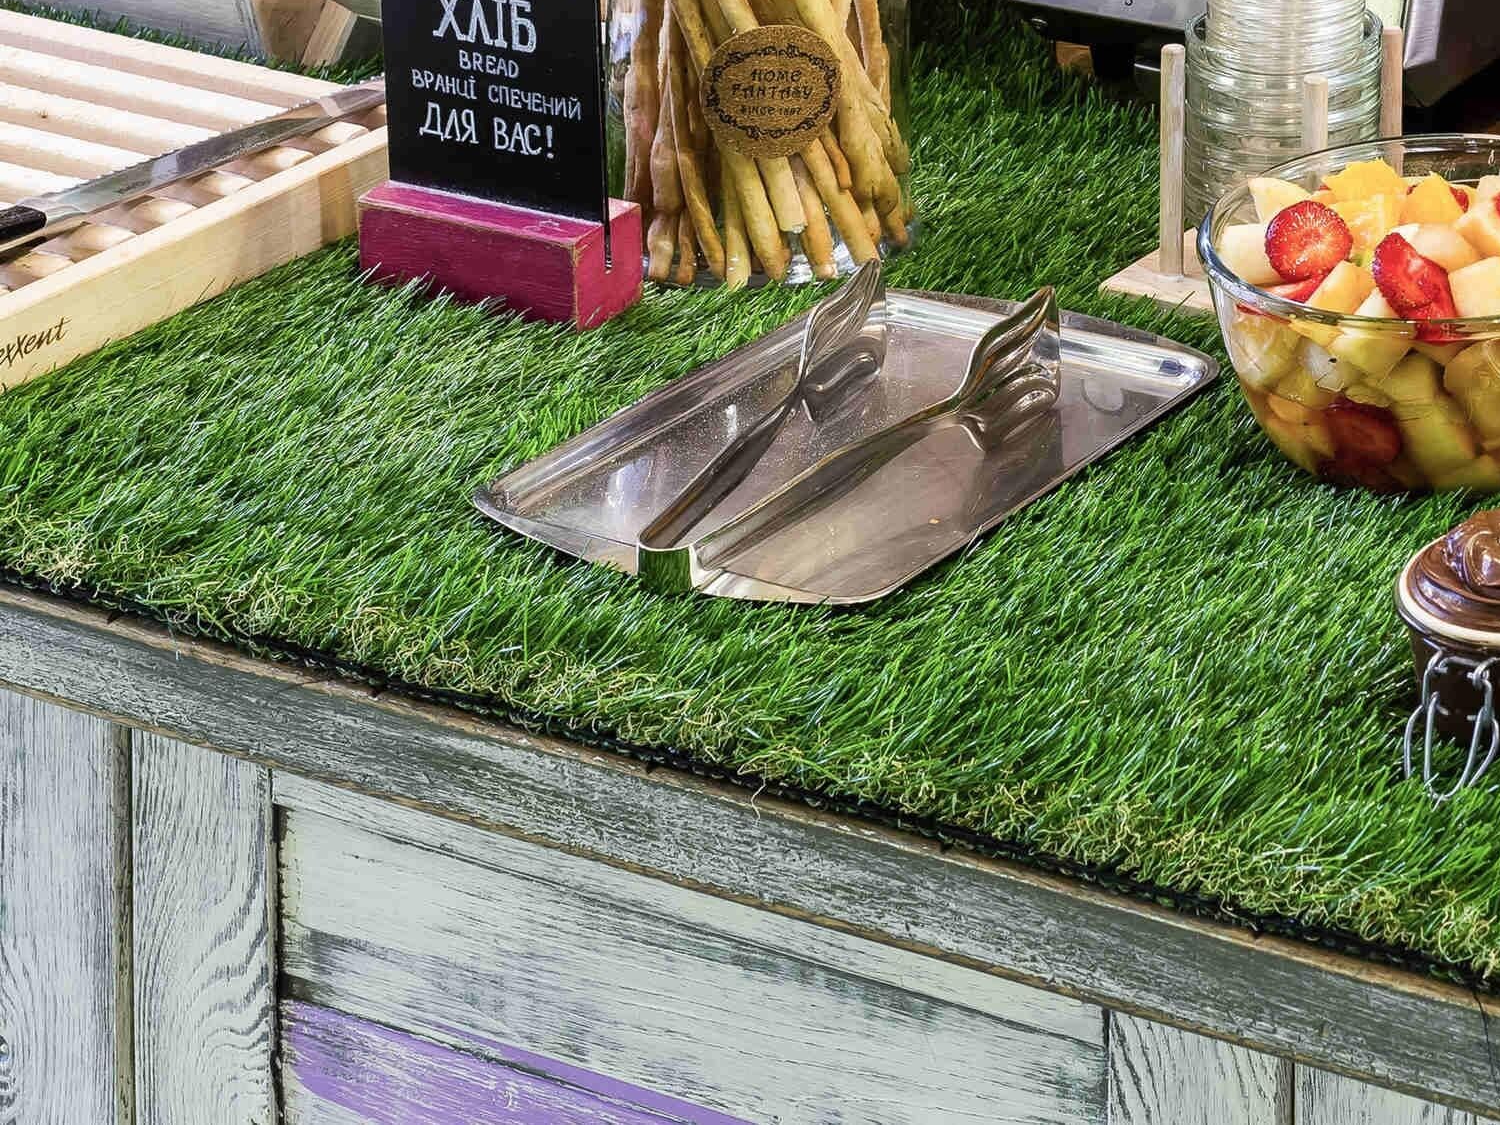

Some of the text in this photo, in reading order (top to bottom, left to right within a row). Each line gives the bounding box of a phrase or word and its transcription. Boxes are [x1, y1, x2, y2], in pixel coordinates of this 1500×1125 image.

[459, 49, 519, 79] BREAD
[752, 69, 801, 82] HOME
[411, 68, 582, 121] ВРАНЦІ СПЕЧЕНИЙ
[419, 101, 554, 159] ДЛЯ ВАС!
